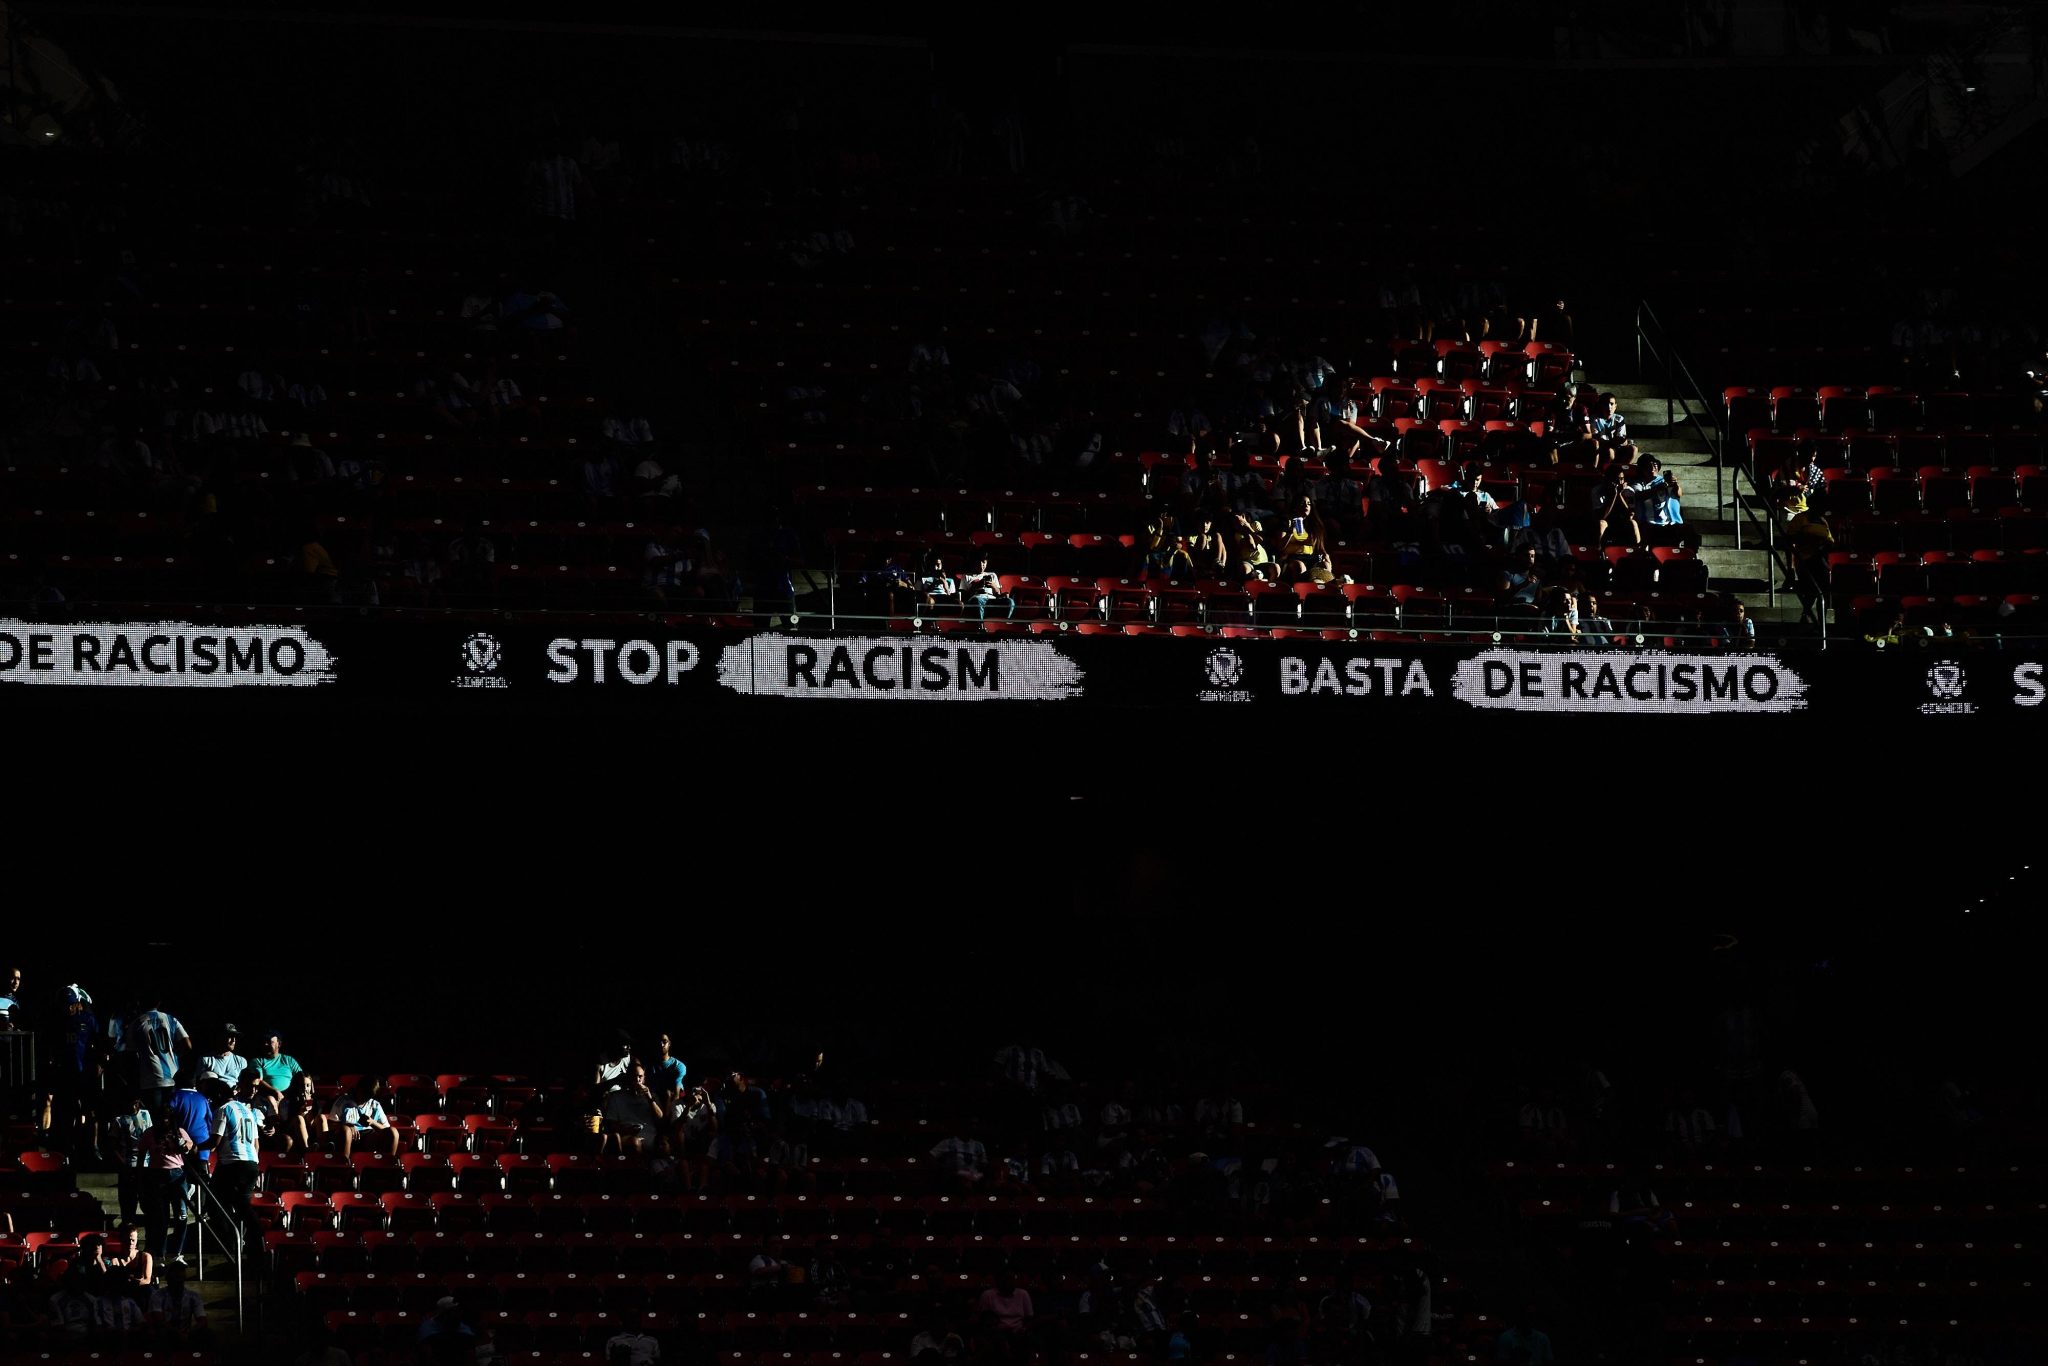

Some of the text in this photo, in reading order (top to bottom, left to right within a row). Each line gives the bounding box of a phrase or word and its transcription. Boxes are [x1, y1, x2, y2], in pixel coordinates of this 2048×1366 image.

[0, 634, 305, 676] DE RACISMO
[547, 638, 999, 691] STOP RACISM
[1281, 656, 1778, 702] BASTA DE RACISMO
[2013, 663, 2046, 706] S
[149, 1028, 169, 1053] 10
[240, 1118, 253, 1143] 10
